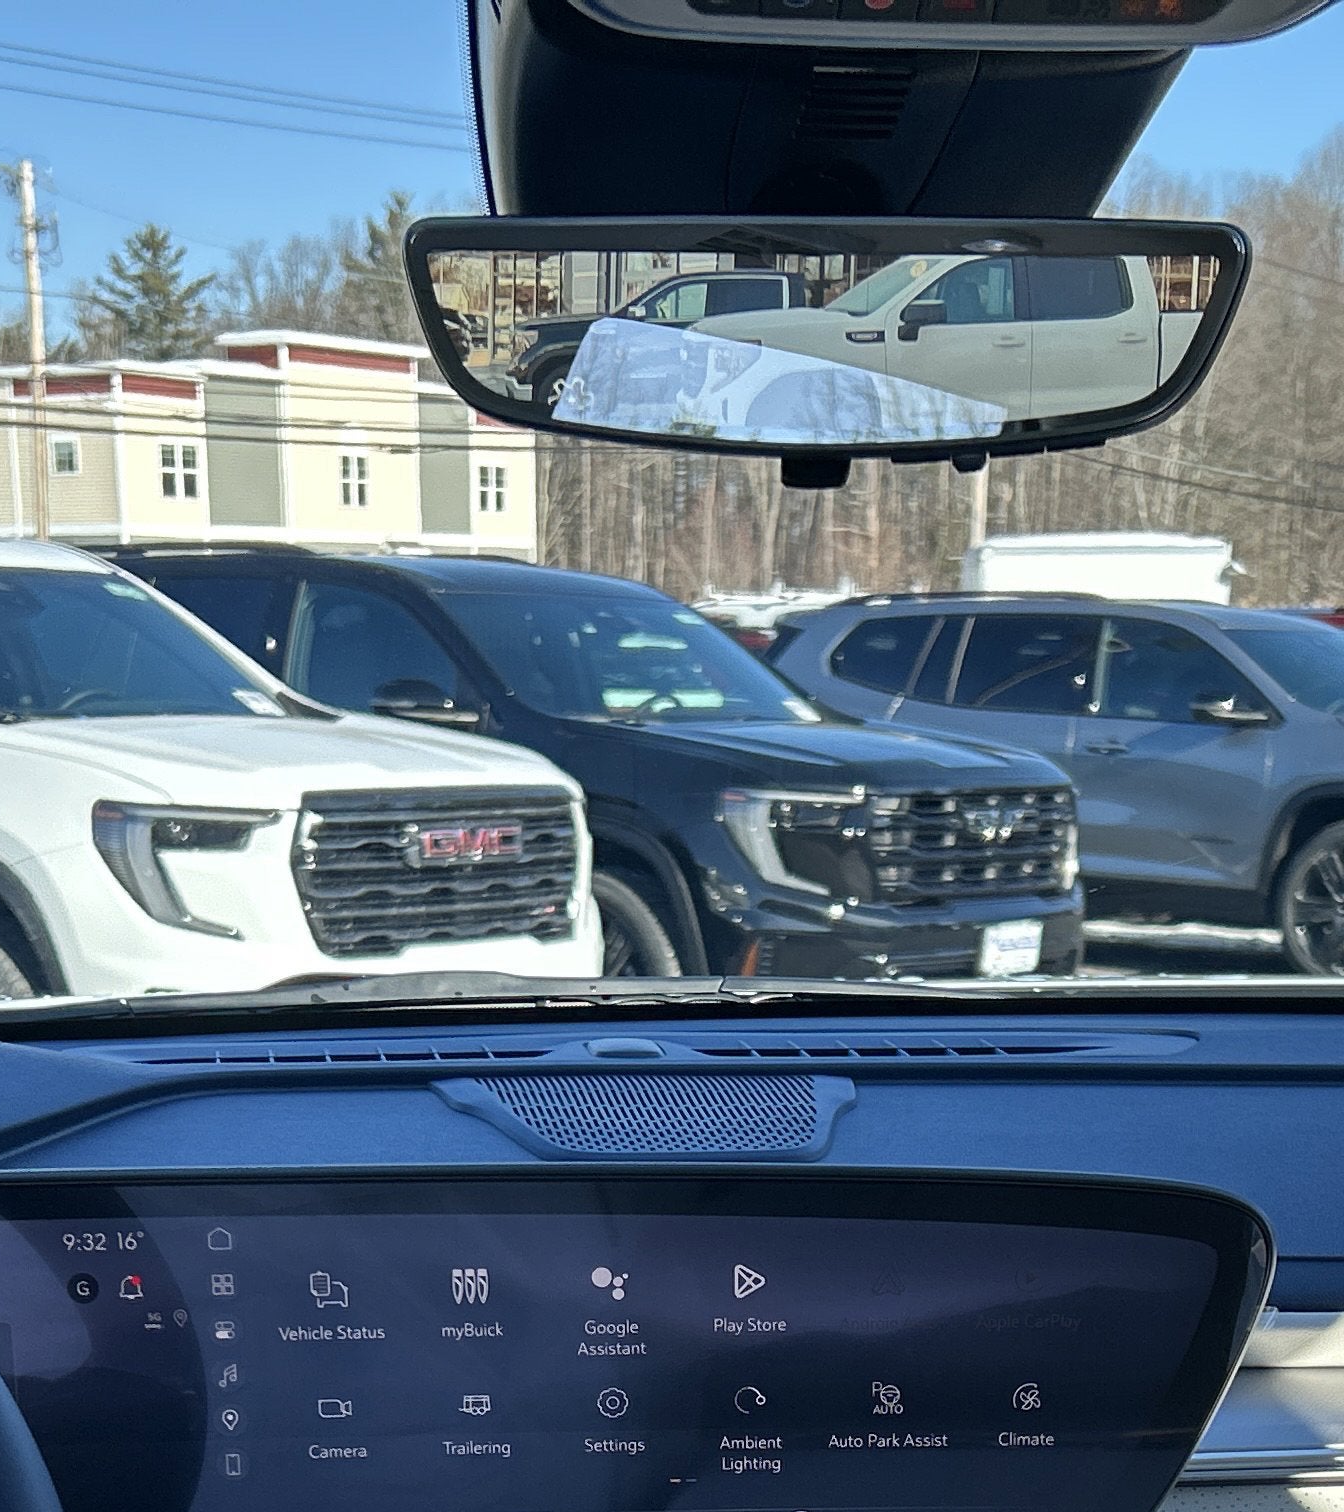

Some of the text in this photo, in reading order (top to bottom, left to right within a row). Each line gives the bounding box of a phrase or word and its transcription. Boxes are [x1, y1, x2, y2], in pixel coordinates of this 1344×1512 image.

[420, 826, 522, 859] GMC
[62, 1230, 144, 1251] 9:32 16°
[278, 1325, 386, 1341] Vehicle Status
[441, 1322, 504, 1341] myBuick
[584, 1319, 639, 1338] Google
[713, 1317, 787, 1335] Play Store
[577, 1341, 647, 1357] Assistant
[584, 1438, 646, 1454] Settings
[719, 1436, 783, 1450] Ambient
[828, 1432, 949, 1448] Auto Park Assist
[997, 1432, 1055, 1447] Climate
[307, 1443, 368, 1459] Camera
[442, 1441, 511, 1458] Trailering
[721, 1457, 782, 1475] Lighting
